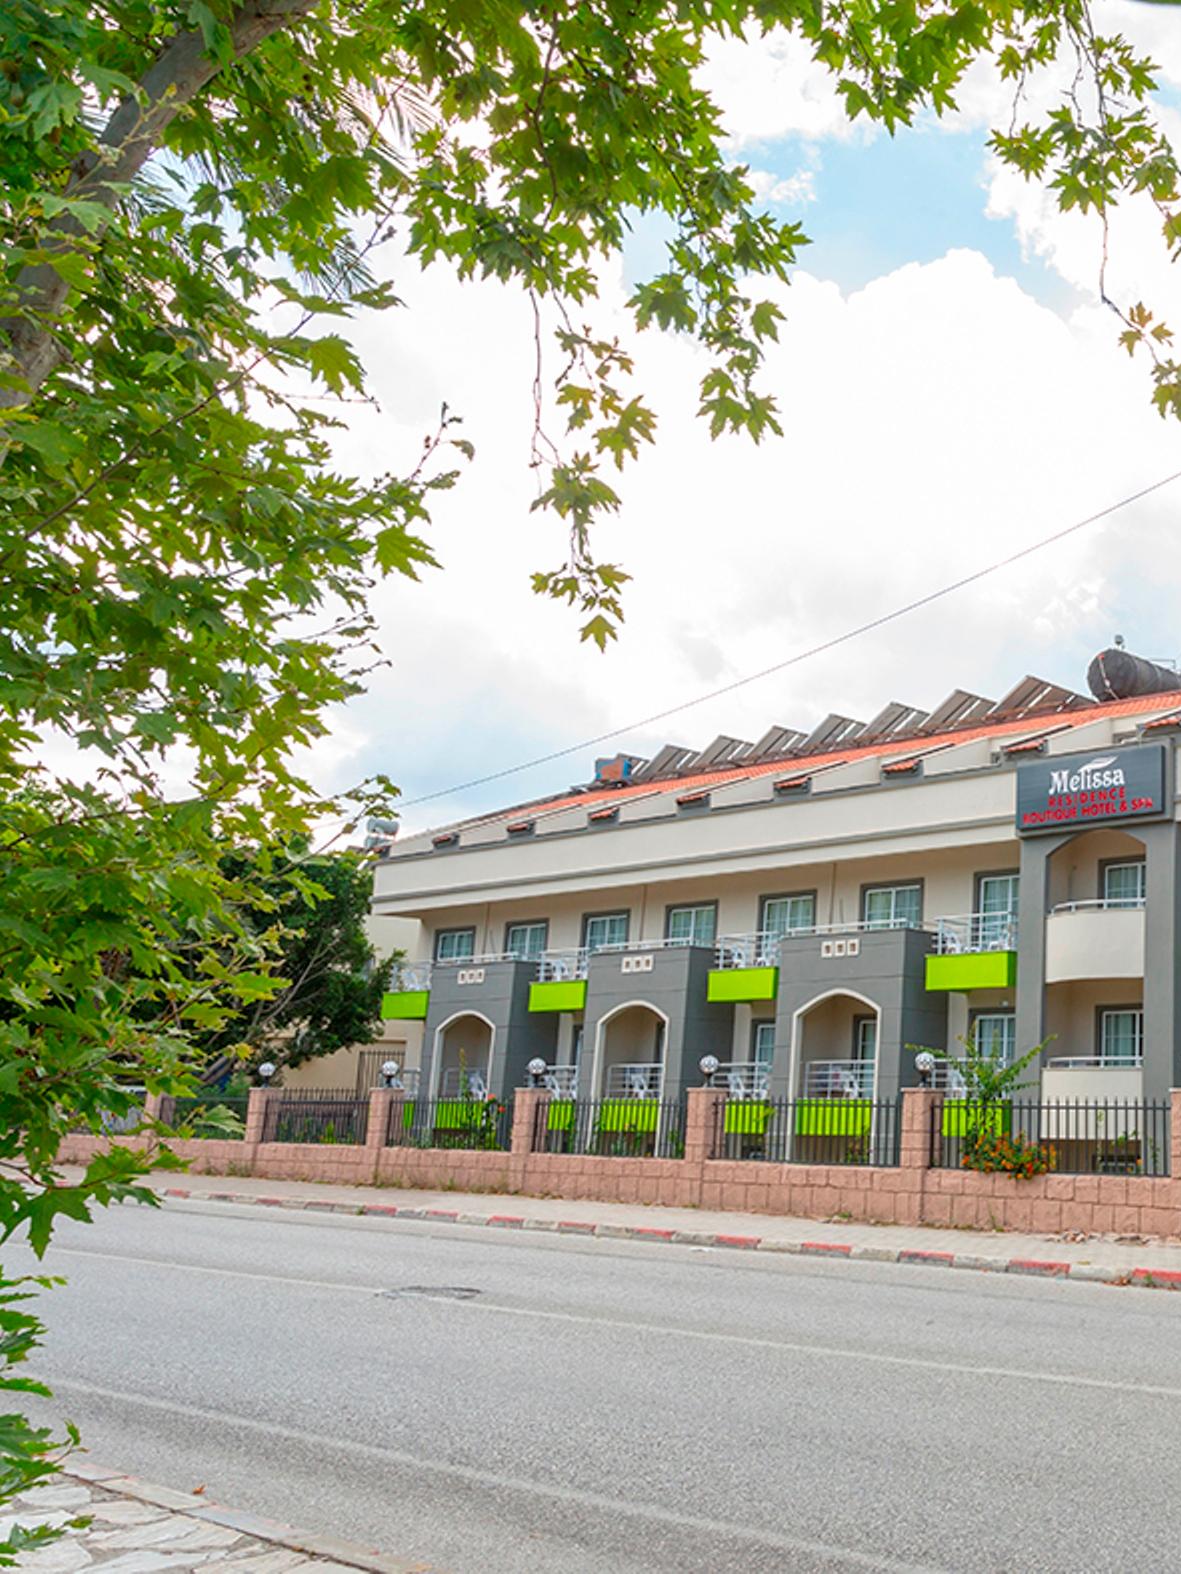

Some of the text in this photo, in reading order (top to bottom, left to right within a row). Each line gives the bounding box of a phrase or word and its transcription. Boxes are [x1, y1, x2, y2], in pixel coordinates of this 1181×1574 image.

[1048, 765, 1126, 795] Melissa
[1023, 797, 1153, 824] BOUTIQUE HOTEL & SPA
[1048, 787, 1126, 808] RESIDENCE
